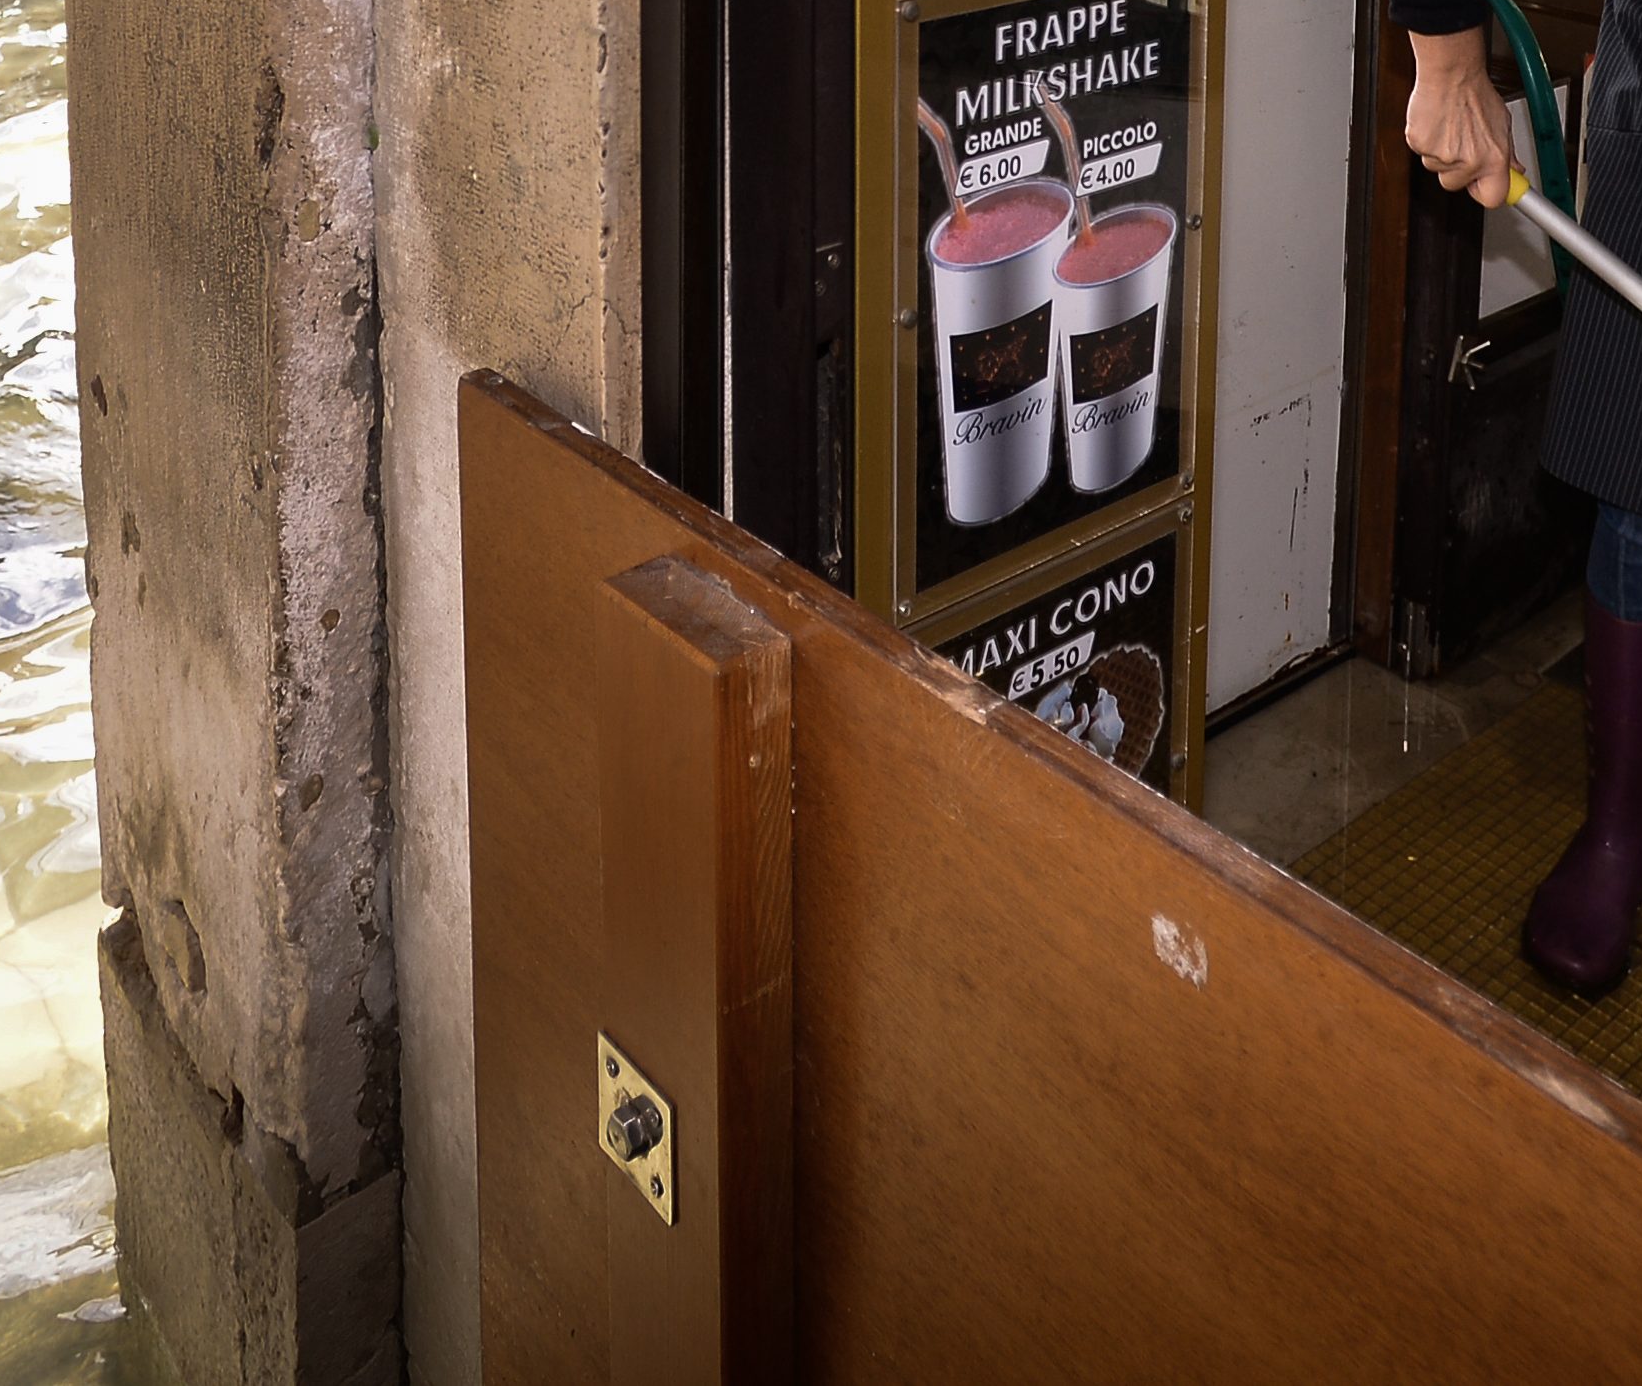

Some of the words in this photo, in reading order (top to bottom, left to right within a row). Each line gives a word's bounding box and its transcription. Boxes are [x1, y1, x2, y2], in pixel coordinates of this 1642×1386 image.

[955, 40, 1161, 127] MILKSHAKE
[964, 116, 1043, 157] GRANDE
[1083, 121, 1158, 159] PICCOLO
[953, 394, 1047, 446] Bravin
[1071, 388, 1154, 436] Bravin
[1049, 560, 1155, 635] CONO
